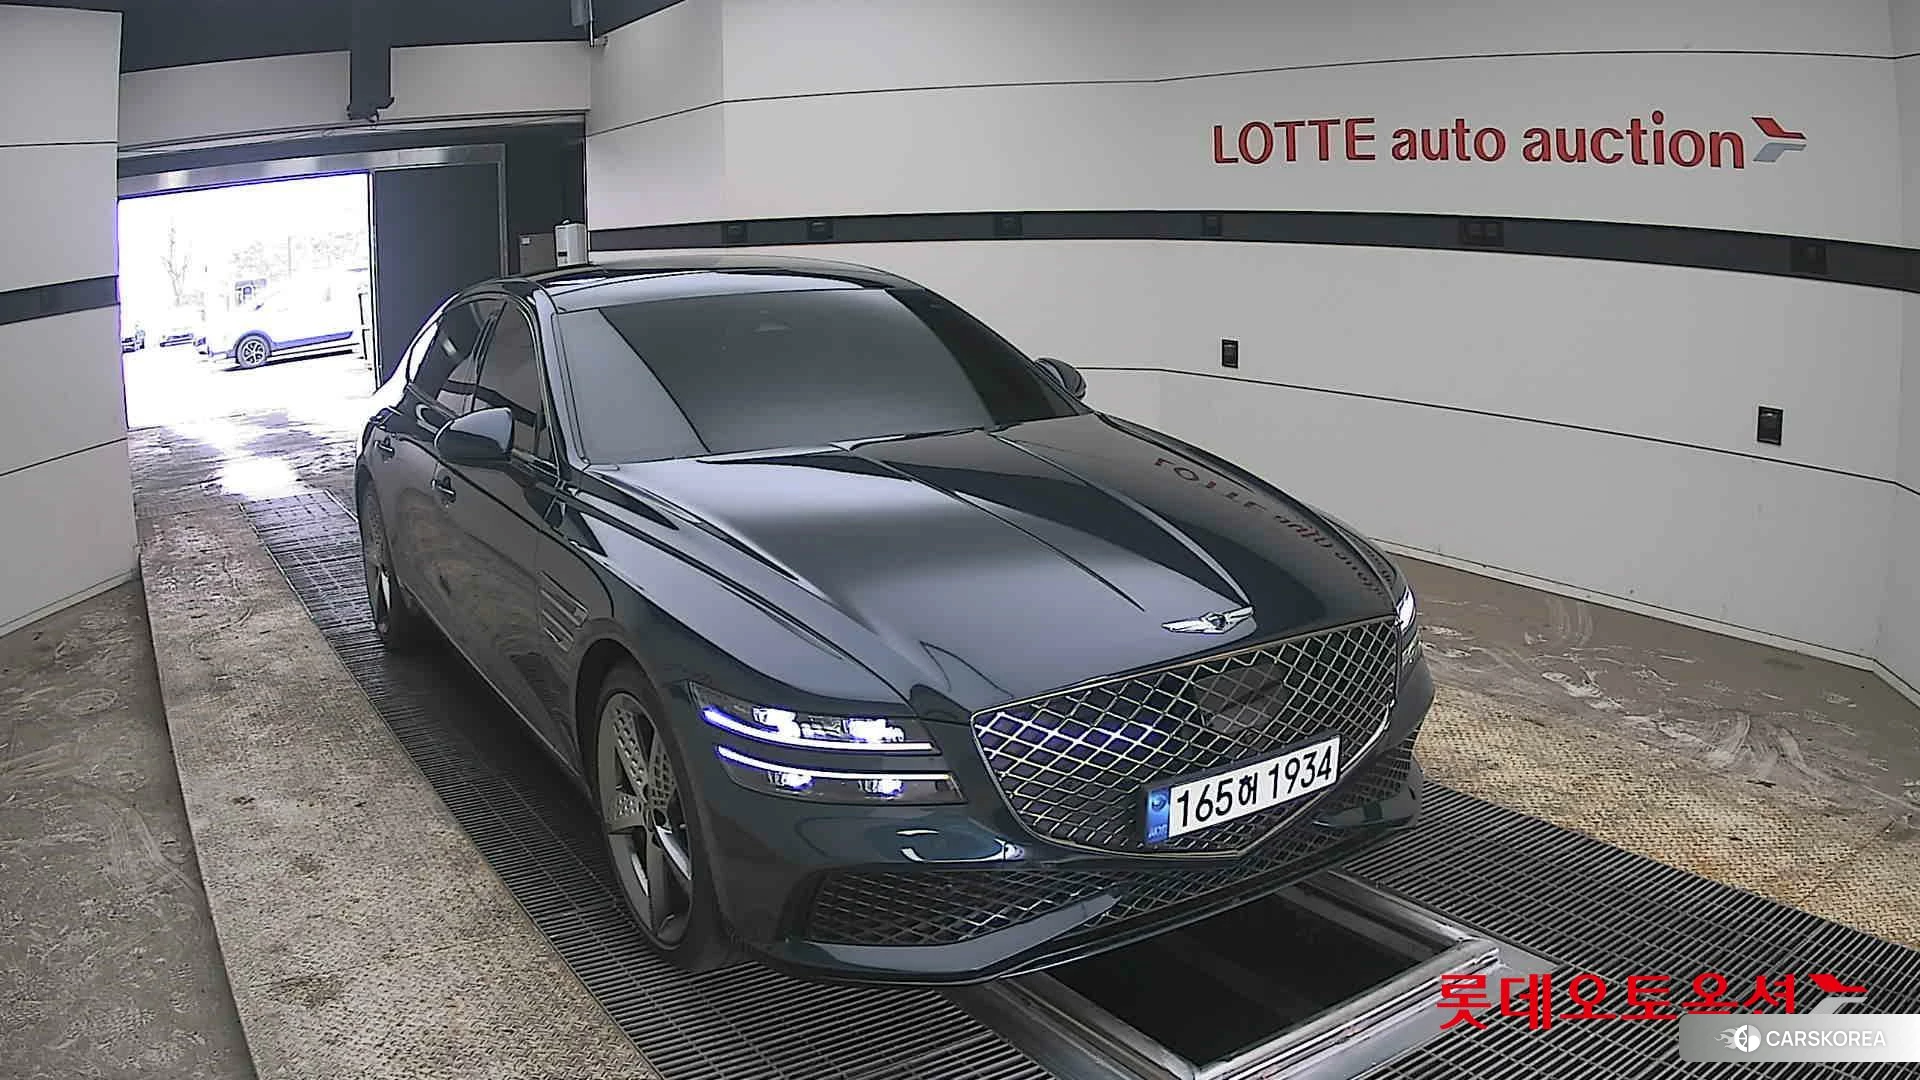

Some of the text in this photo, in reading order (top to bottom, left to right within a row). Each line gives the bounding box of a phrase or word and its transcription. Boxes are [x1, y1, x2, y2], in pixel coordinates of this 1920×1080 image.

[1213, 110, 1744, 169] LOTTE auto auction
[1177, 746, 1332, 827] 165허 1934
